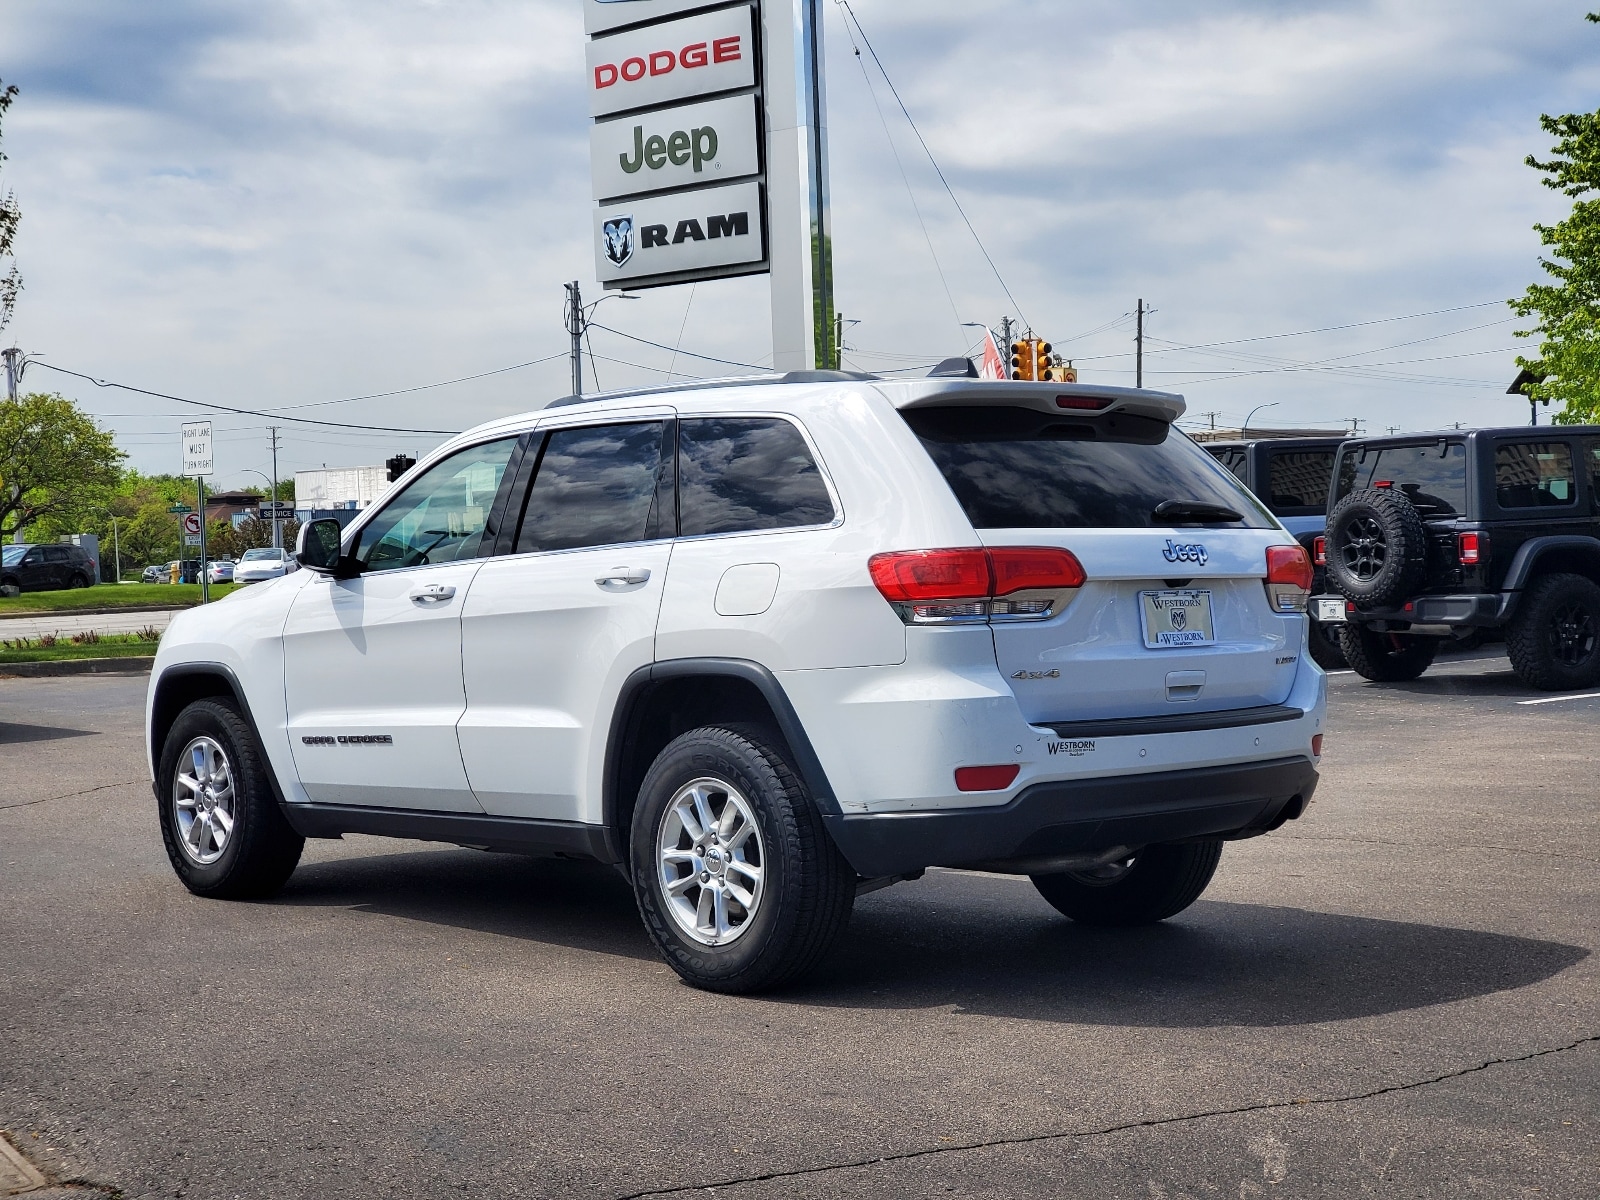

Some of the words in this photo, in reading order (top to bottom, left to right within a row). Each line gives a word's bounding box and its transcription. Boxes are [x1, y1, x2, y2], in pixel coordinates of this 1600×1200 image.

[594, 35, 742, 90] DODGE
[619, 125, 718, 174] Jeep
[640, 211, 749, 249] RAM
[183, 428, 197, 438] RIGHT
[198, 427, 210, 437] LANE
[189, 443, 205, 454] MUST
[184, 460, 197, 470] TURN
[197, 459, 212, 469] RIGHT
[1162, 539, 1209, 567] Jeep
[1151, 599, 1202, 611] WESTBORN
[1161, 632, 1204, 645] WESTBORN
[1010, 668, 1061, 680] 4x4
[1047, 740, 1096, 756] WESTBORN
[637, 868, 734, 971] GOODYEAR
